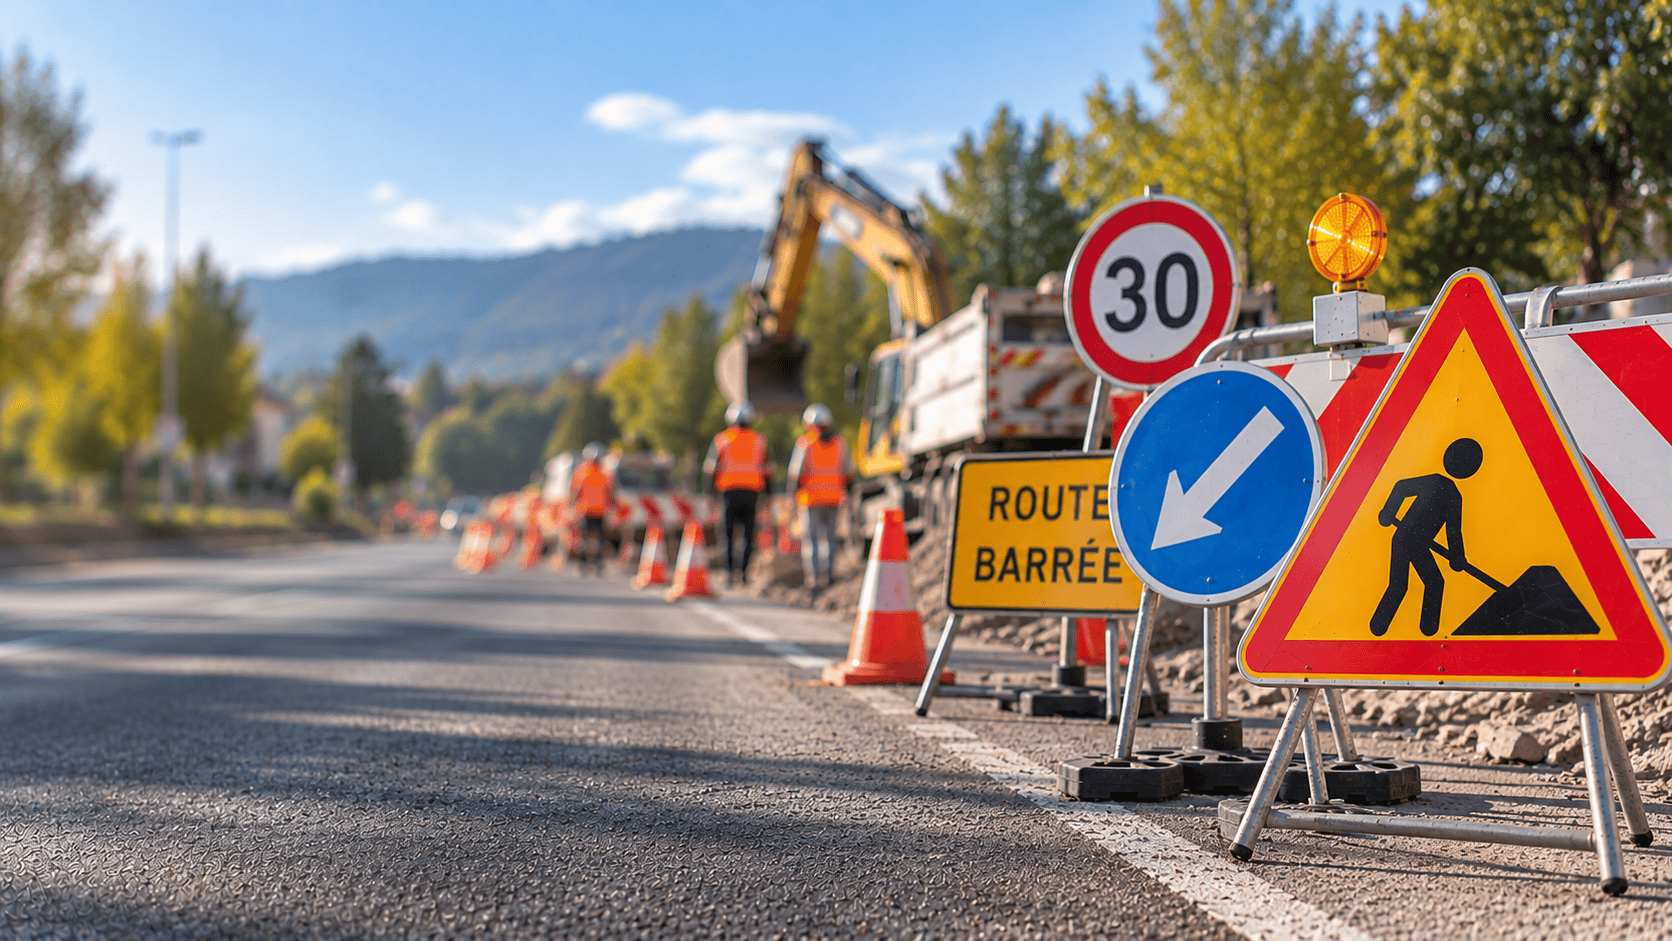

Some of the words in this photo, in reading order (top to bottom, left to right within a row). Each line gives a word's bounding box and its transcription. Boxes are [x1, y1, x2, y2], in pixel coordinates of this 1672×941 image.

[1105, 251, 1200, 333] 30
[989, 484, 1109, 521] ROUTE
[974, 538, 1123, 583] BARRÉE
